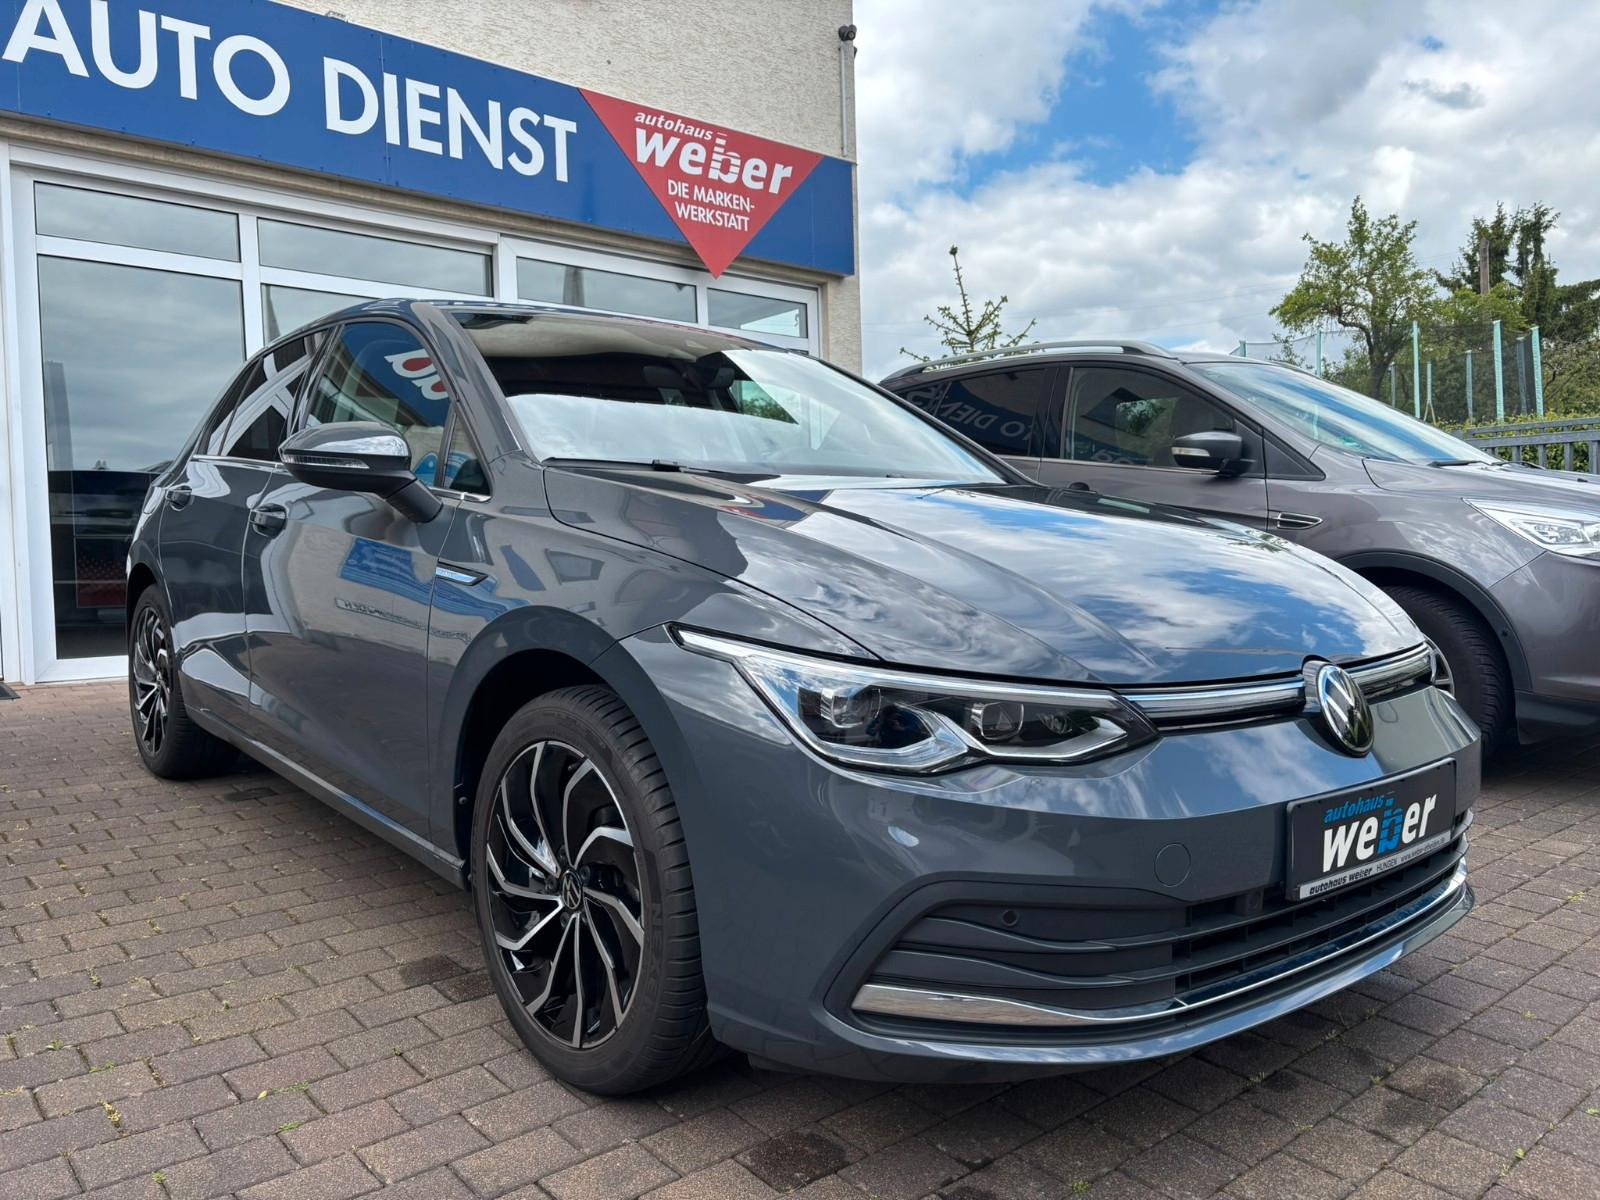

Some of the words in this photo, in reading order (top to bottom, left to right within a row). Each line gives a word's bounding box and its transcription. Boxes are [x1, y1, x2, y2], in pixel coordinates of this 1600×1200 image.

[2, 0, 290, 116] AUTO
[323, 56, 577, 183] DIENST
[634, 111, 713, 141] autohaus
[667, 179, 690, 199] DIE
[693, 184, 755, 213] MARKEN-
[675, 201, 750, 232] WERKSTATT
[1324, 795, 1384, 824] autohaus
[1309, 875, 1348, 895] autohaus
